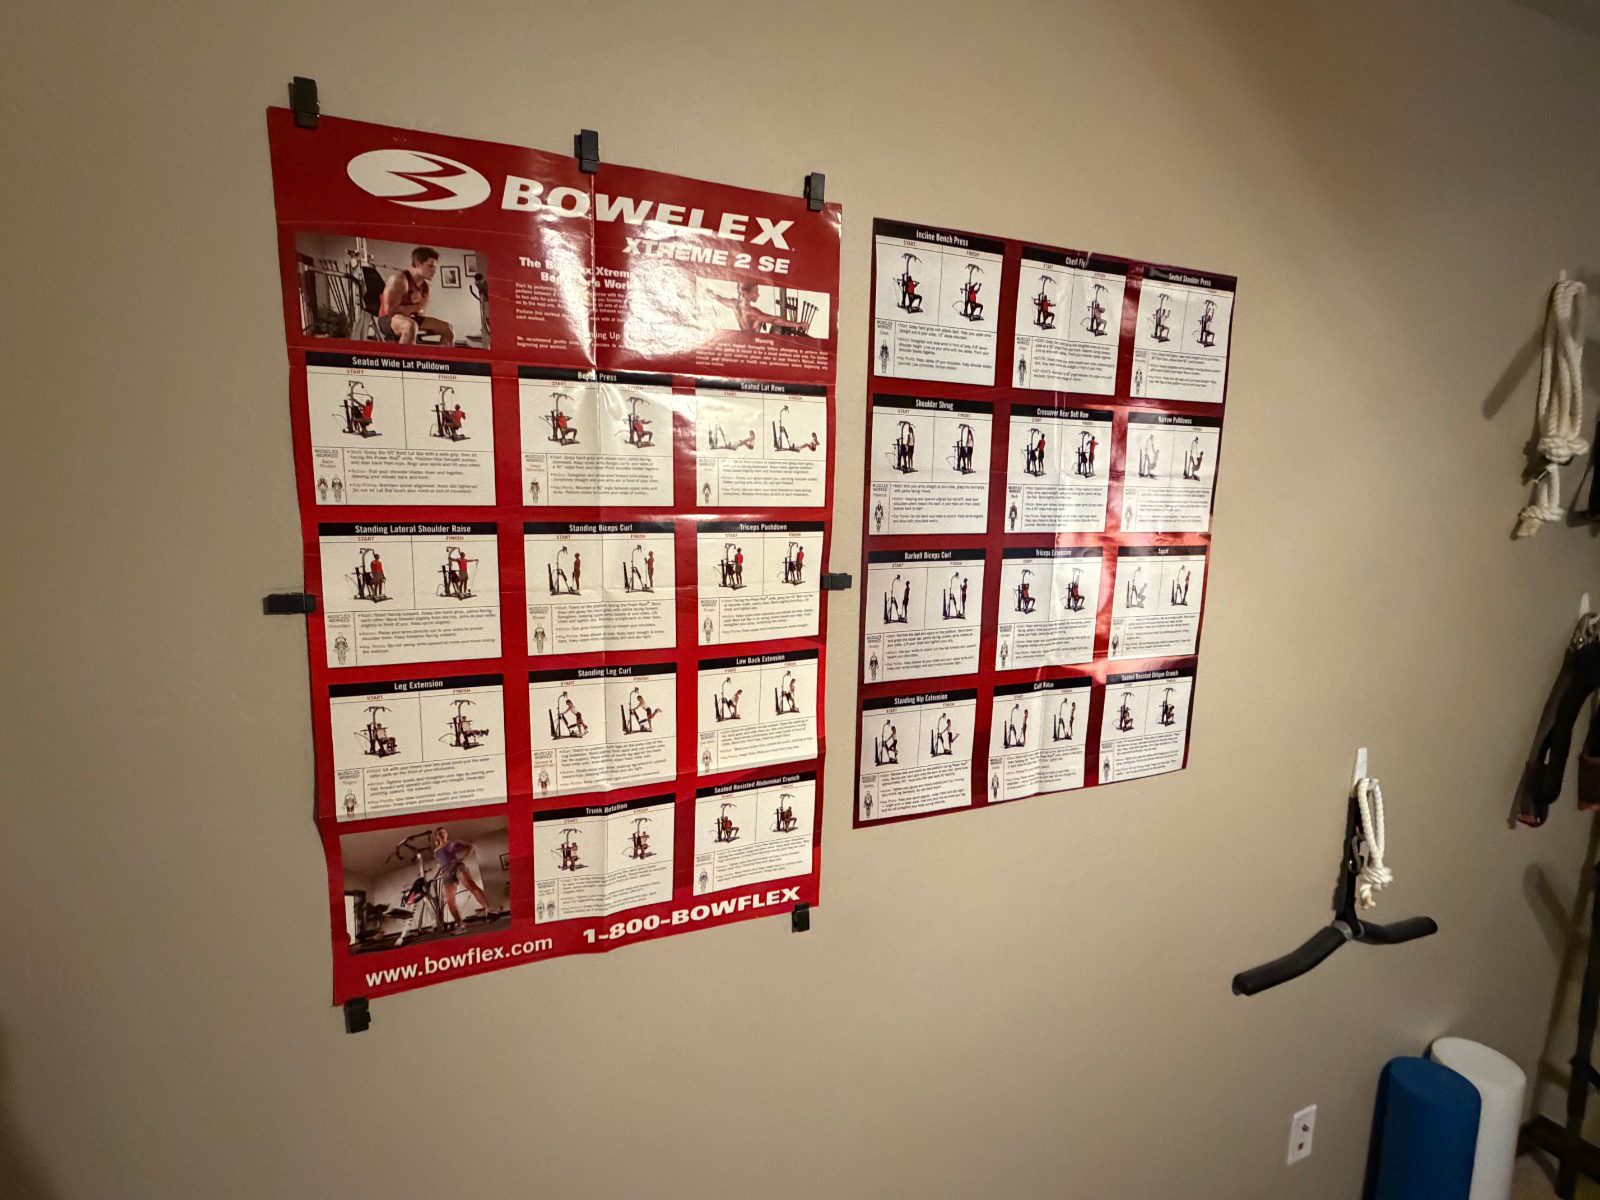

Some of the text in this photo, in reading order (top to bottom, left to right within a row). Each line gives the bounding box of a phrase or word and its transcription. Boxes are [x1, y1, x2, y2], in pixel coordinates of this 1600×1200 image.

[501, 174, 795, 252] BOWFLEX
[916, 230, 969, 247] Incline Bench Press
[622, 237, 790, 274] XTREME 2 SE
[519, 257, 541, 269] The
[1066, 257, 1086, 268] Chest Fly
[609, 331, 620, 340] Up
[352, 356, 449, 371] Seated Wide Lat Pulldown
[599, 373, 617, 381] Press
[741, 383, 760, 391] Seated
[916, 399, 953, 410] Shoulder Shrug
[1037, 408, 1058, 416] Crossover
[355, 525, 388, 534] Standing
[390, 525, 416, 533] Lateral
[418, 525, 450, 533] Shoulder
[569, 524, 597, 533] Standing
[599, 524, 618, 532] Biceps
[905, 552, 922, 560] Barbell
[924, 552, 940, 560] Biceps
[748, 656, 761, 664] Back
[762, 654, 785, 662] Extension
[578, 667, 631, 677] Standing Leg Curl
[394, 680, 443, 692] Leg Extension
[894, 696, 915, 705] Standing
[925, 693, 948, 701] Extension
[715, 785, 732, 793] Seated
[733, 781, 755, 790] Resisted
[756, 778, 781, 787] Abdominal
[604, 803, 628, 813] Rotation
[583, 886, 801, 945] 1-800-BOWFLEX
[365, 934, 553, 988] www.bowflex.com
